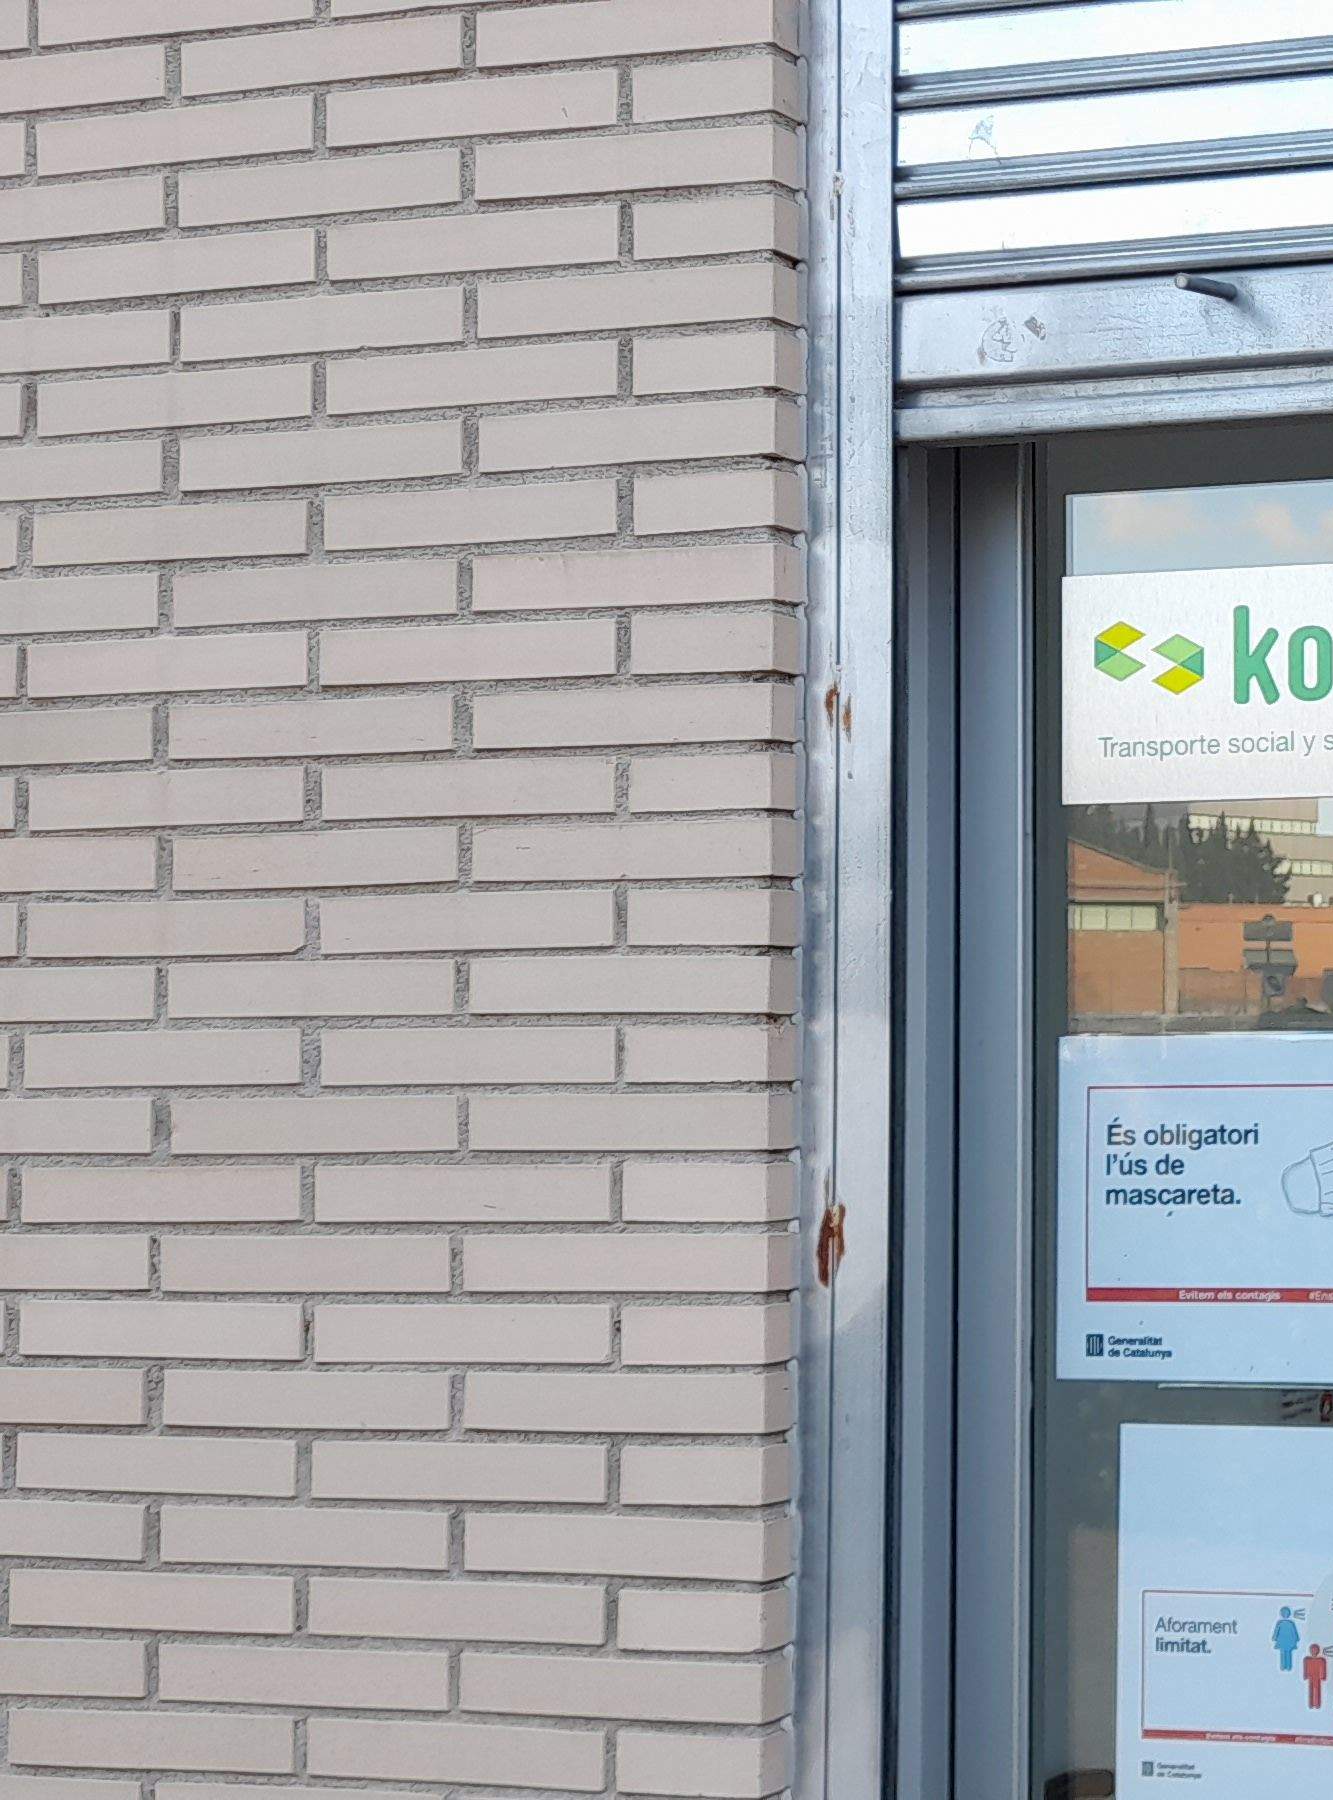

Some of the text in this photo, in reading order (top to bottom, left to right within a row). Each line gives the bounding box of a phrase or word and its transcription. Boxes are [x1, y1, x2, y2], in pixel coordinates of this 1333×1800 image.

[1098, 733, 1221, 762] Transporte
[1228, 730, 1296, 755] social
[1302, 735, 1314, 757] y
[1106, 1117, 1259, 1150] És obligatori
[1155, 1152, 1185, 1175] de
[1105, 1183, 1241, 1205] mascareta.
[1154, 1616, 1238, 1635] Aforament
[1155, 1637, 1212, 1655] limitat.
